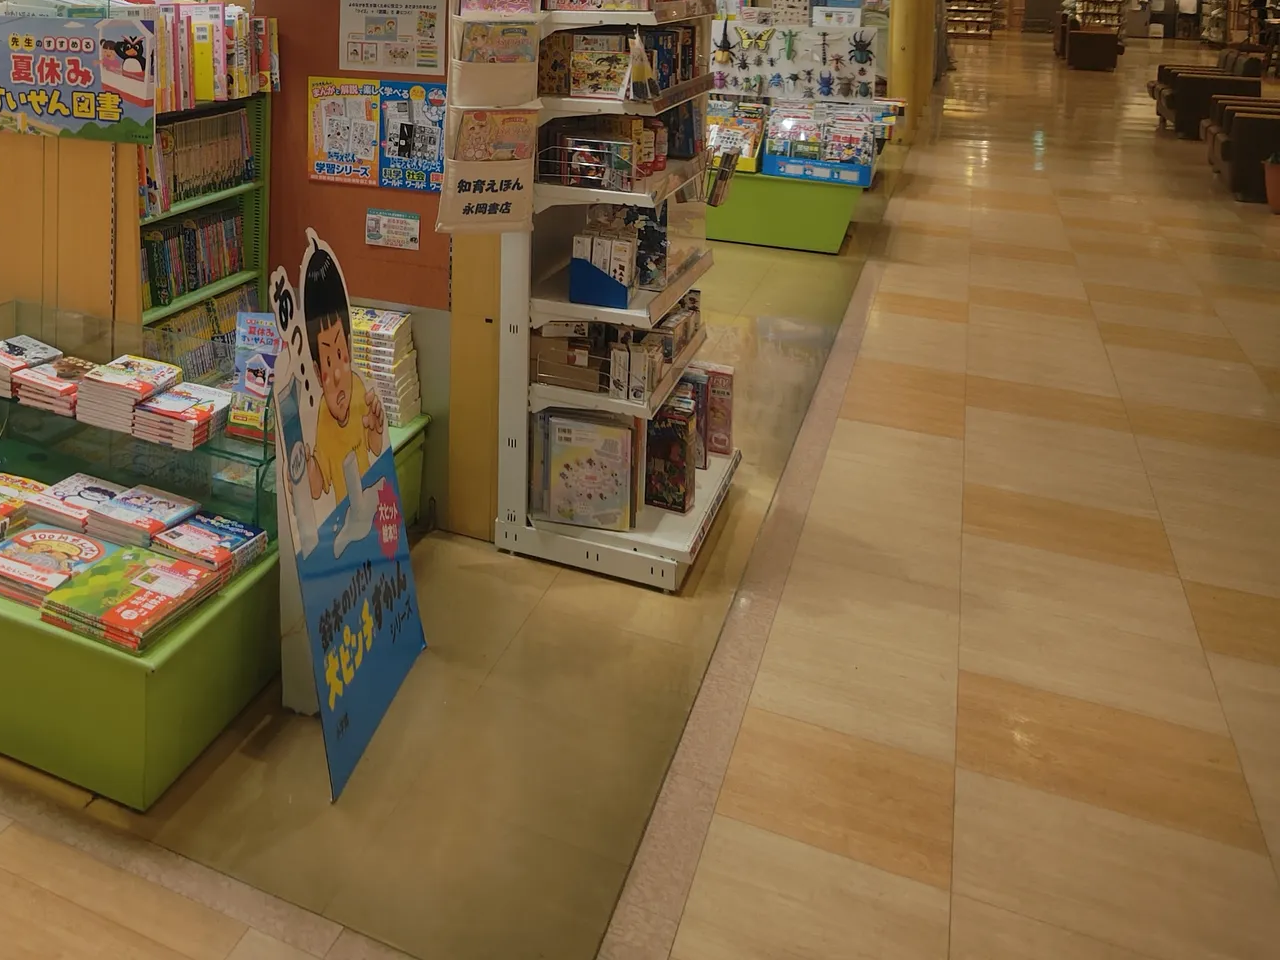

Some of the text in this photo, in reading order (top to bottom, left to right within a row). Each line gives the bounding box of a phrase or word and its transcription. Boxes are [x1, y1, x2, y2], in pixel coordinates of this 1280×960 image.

[10, 37, 94, 50] 先生のすすめる
[11, 53, 93, 86] 夏休み
[314, 161, 372, 179] 学習シリーズ
[406, 170, 427, 182] 社会
[457, 177, 524, 194] 知育えほん
[461, 201, 513, 215] 永岡書店
[247, 326, 275, 339] 夏休み
[378, 502, 399, 521] 大ヒット
[319, 559, 372, 652] 鈴木のりたけ
